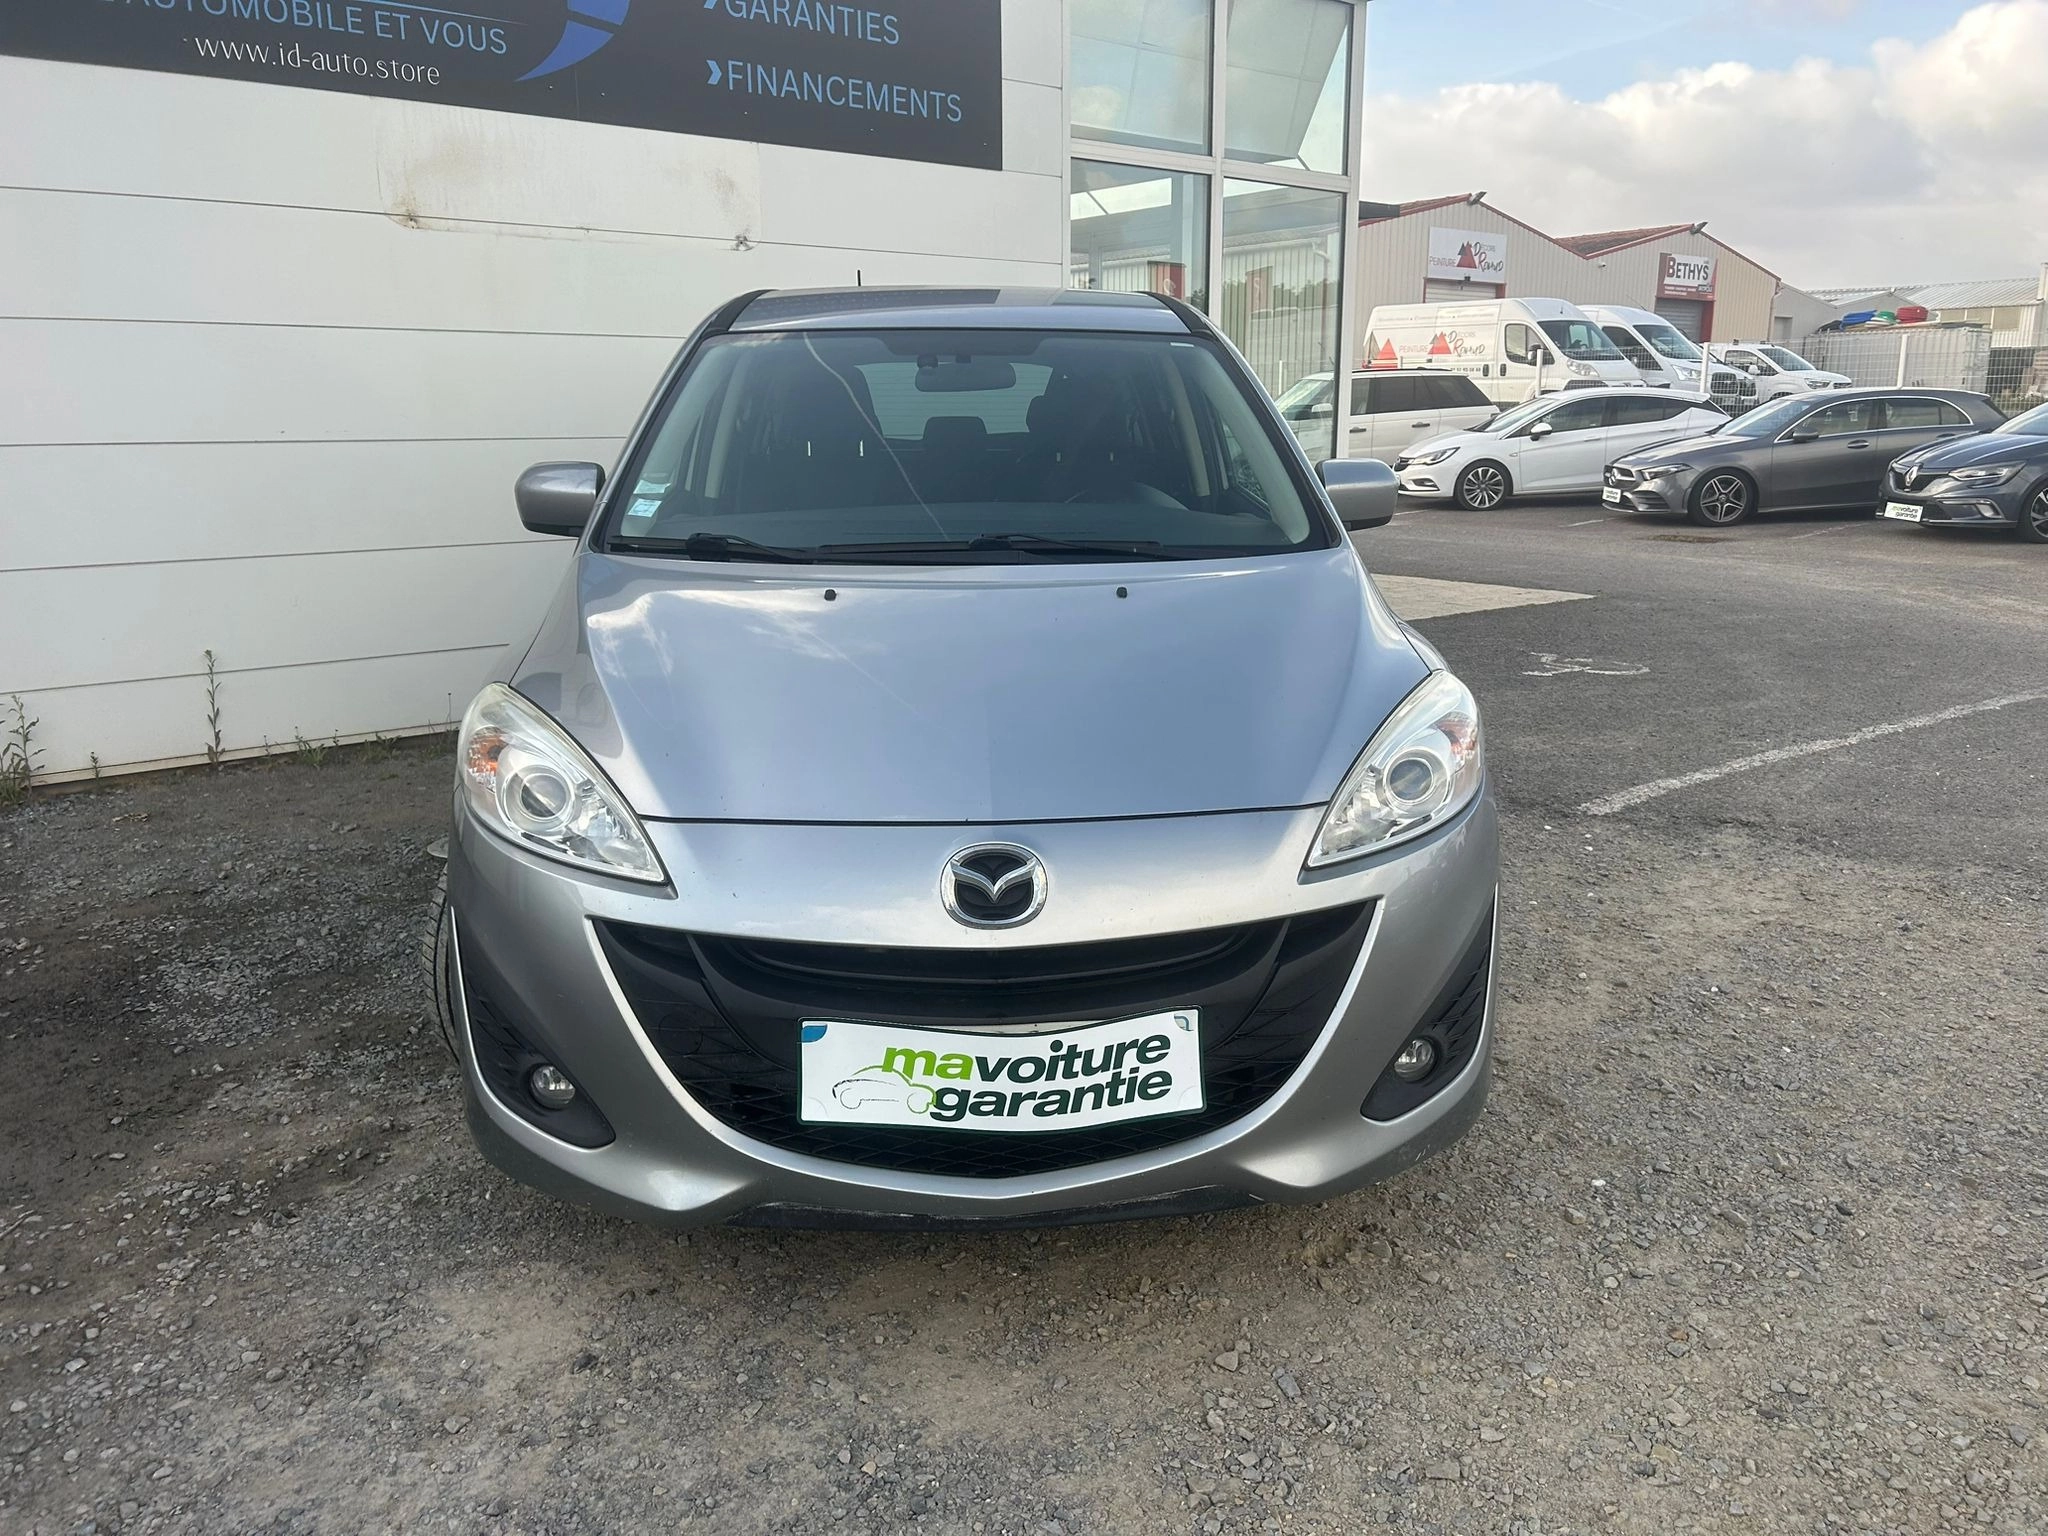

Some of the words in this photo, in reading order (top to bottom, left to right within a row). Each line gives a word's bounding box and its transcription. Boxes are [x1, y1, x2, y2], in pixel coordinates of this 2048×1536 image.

[375, 10, 411, 40] ET
[419, 17, 507, 54] VOUS
[725, 0, 899, 45] GARANTIES
[194, 37, 440, 85] www.id-auto.store
[727, 60, 962, 122] FINANCEMENTS
[1667, 256, 1709, 281] BETHYS
[930, 1066, 1173, 1122] garantie
